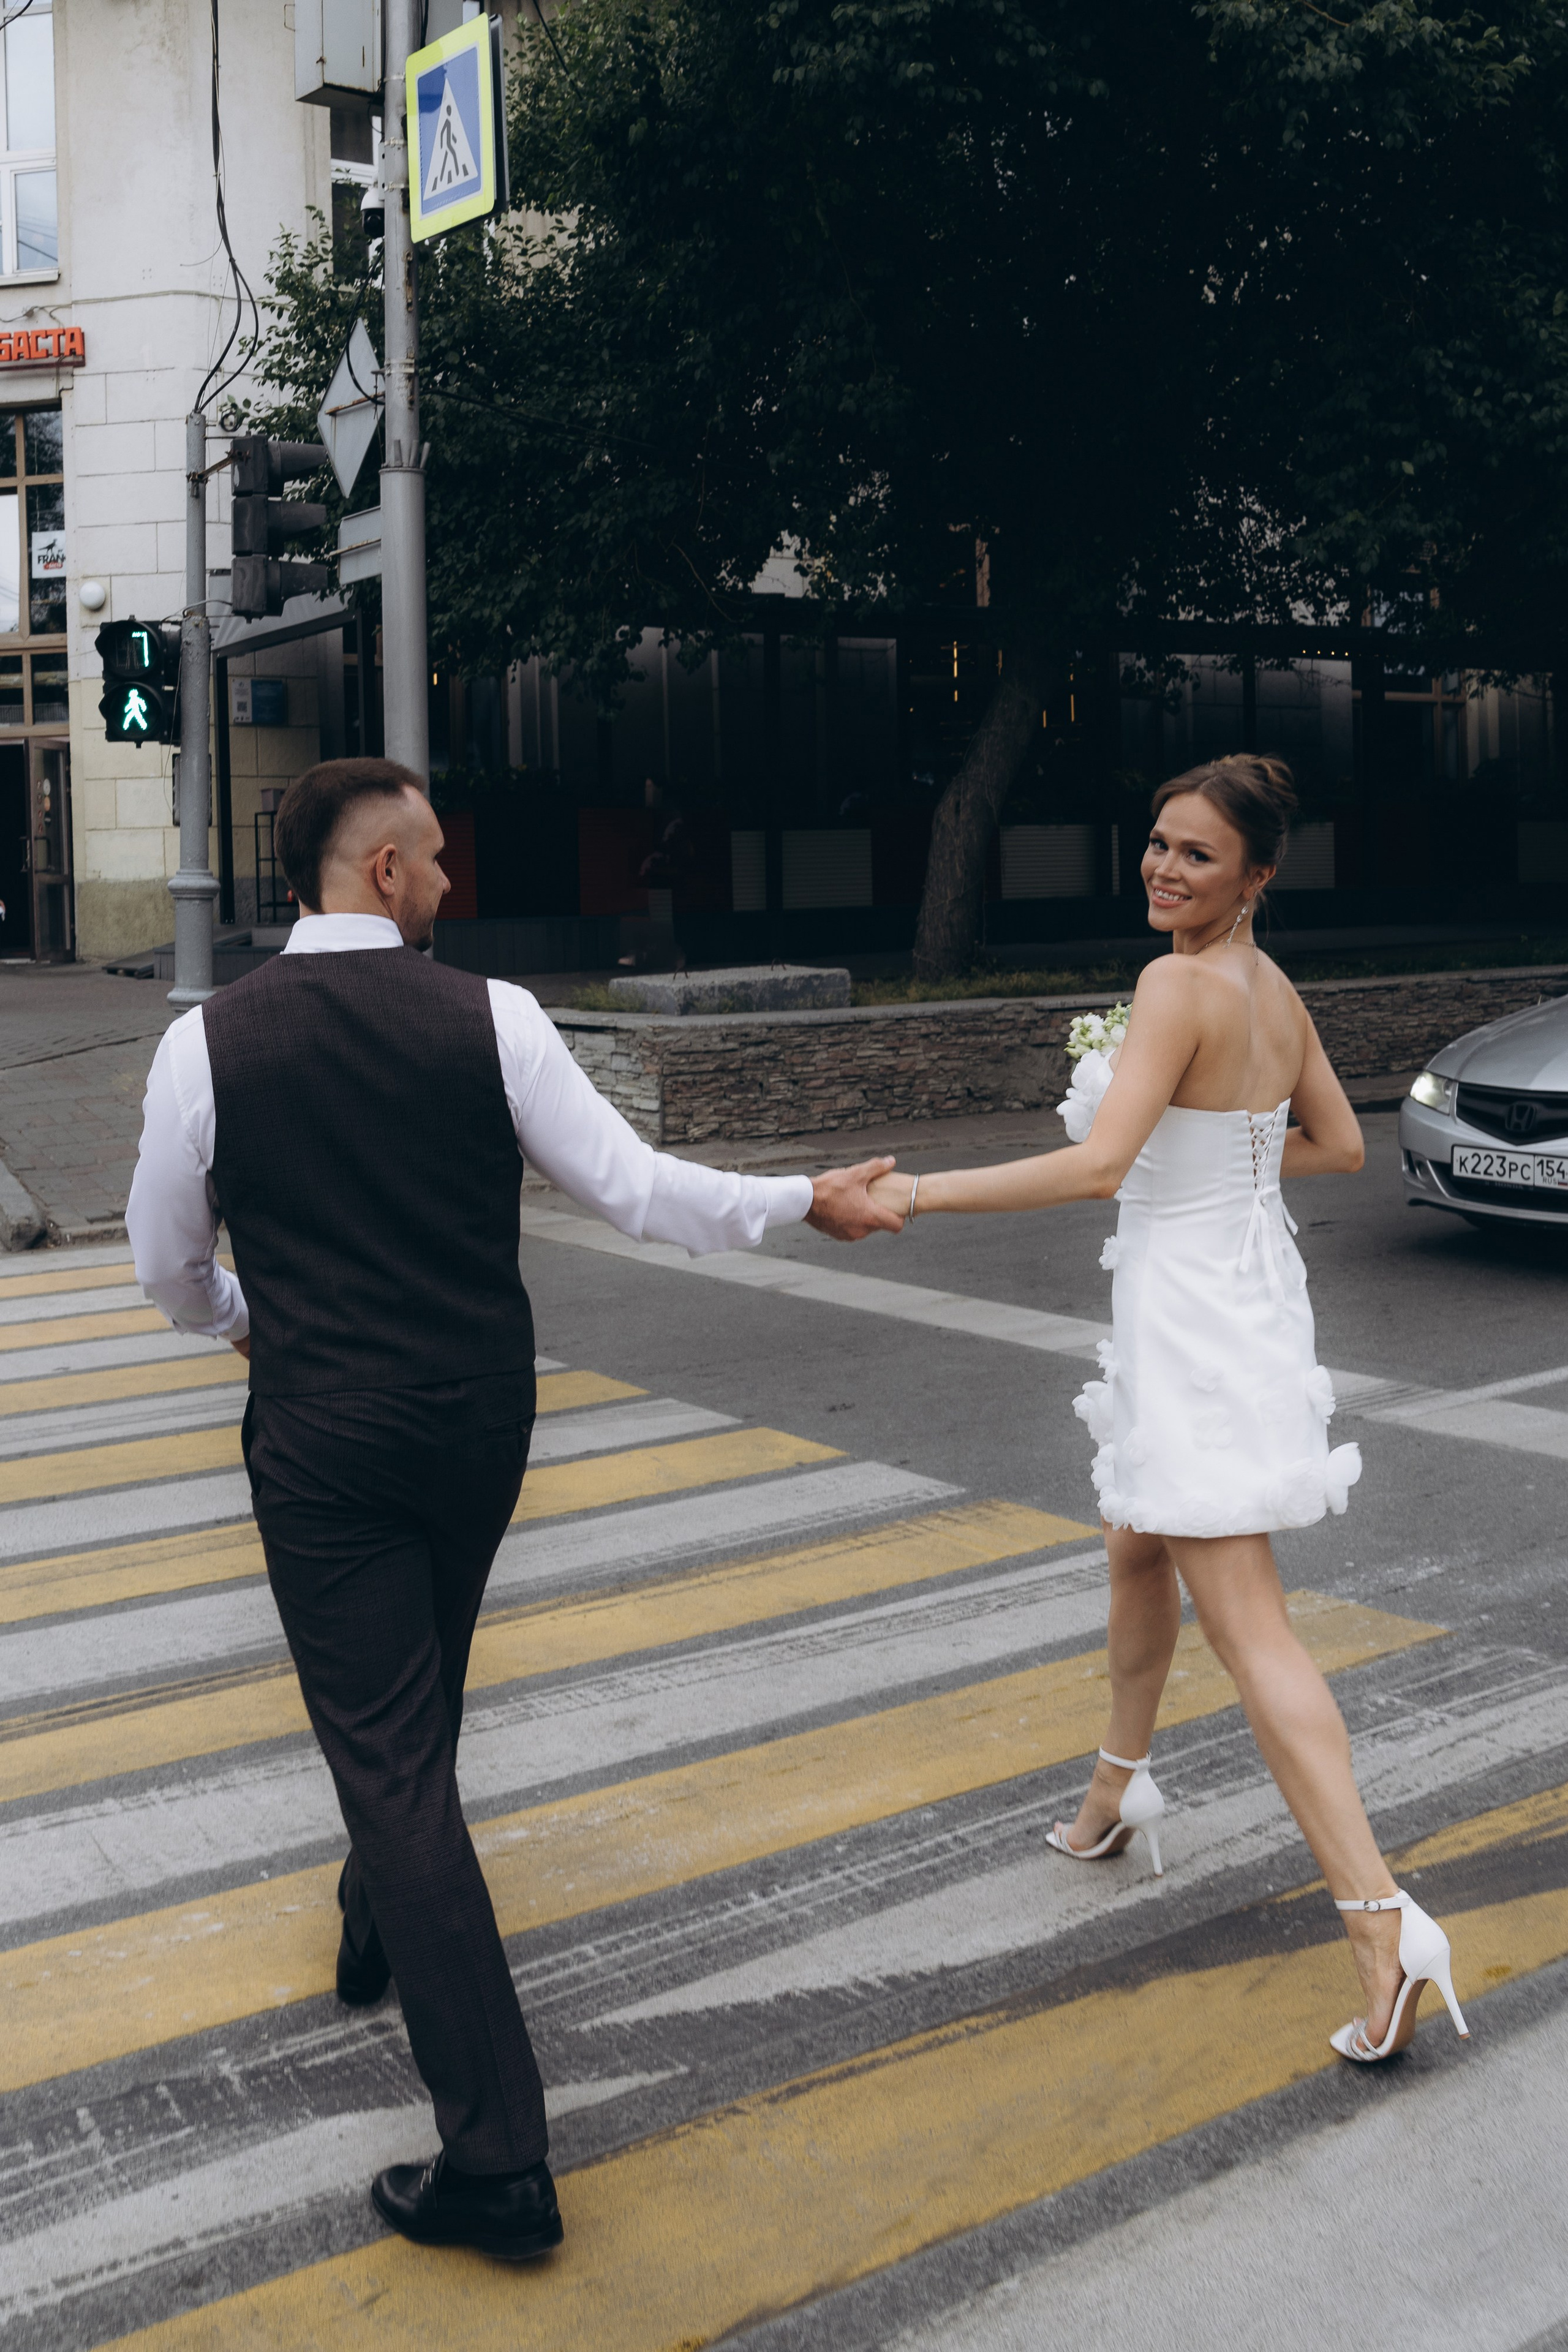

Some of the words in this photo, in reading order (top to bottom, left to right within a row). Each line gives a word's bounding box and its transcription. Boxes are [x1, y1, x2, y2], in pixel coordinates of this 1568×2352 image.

[132, 631, 149, 667] 7
[1537, 1159, 1566, 1179] 154
[1542, 1177, 1558, 1185] RUS
